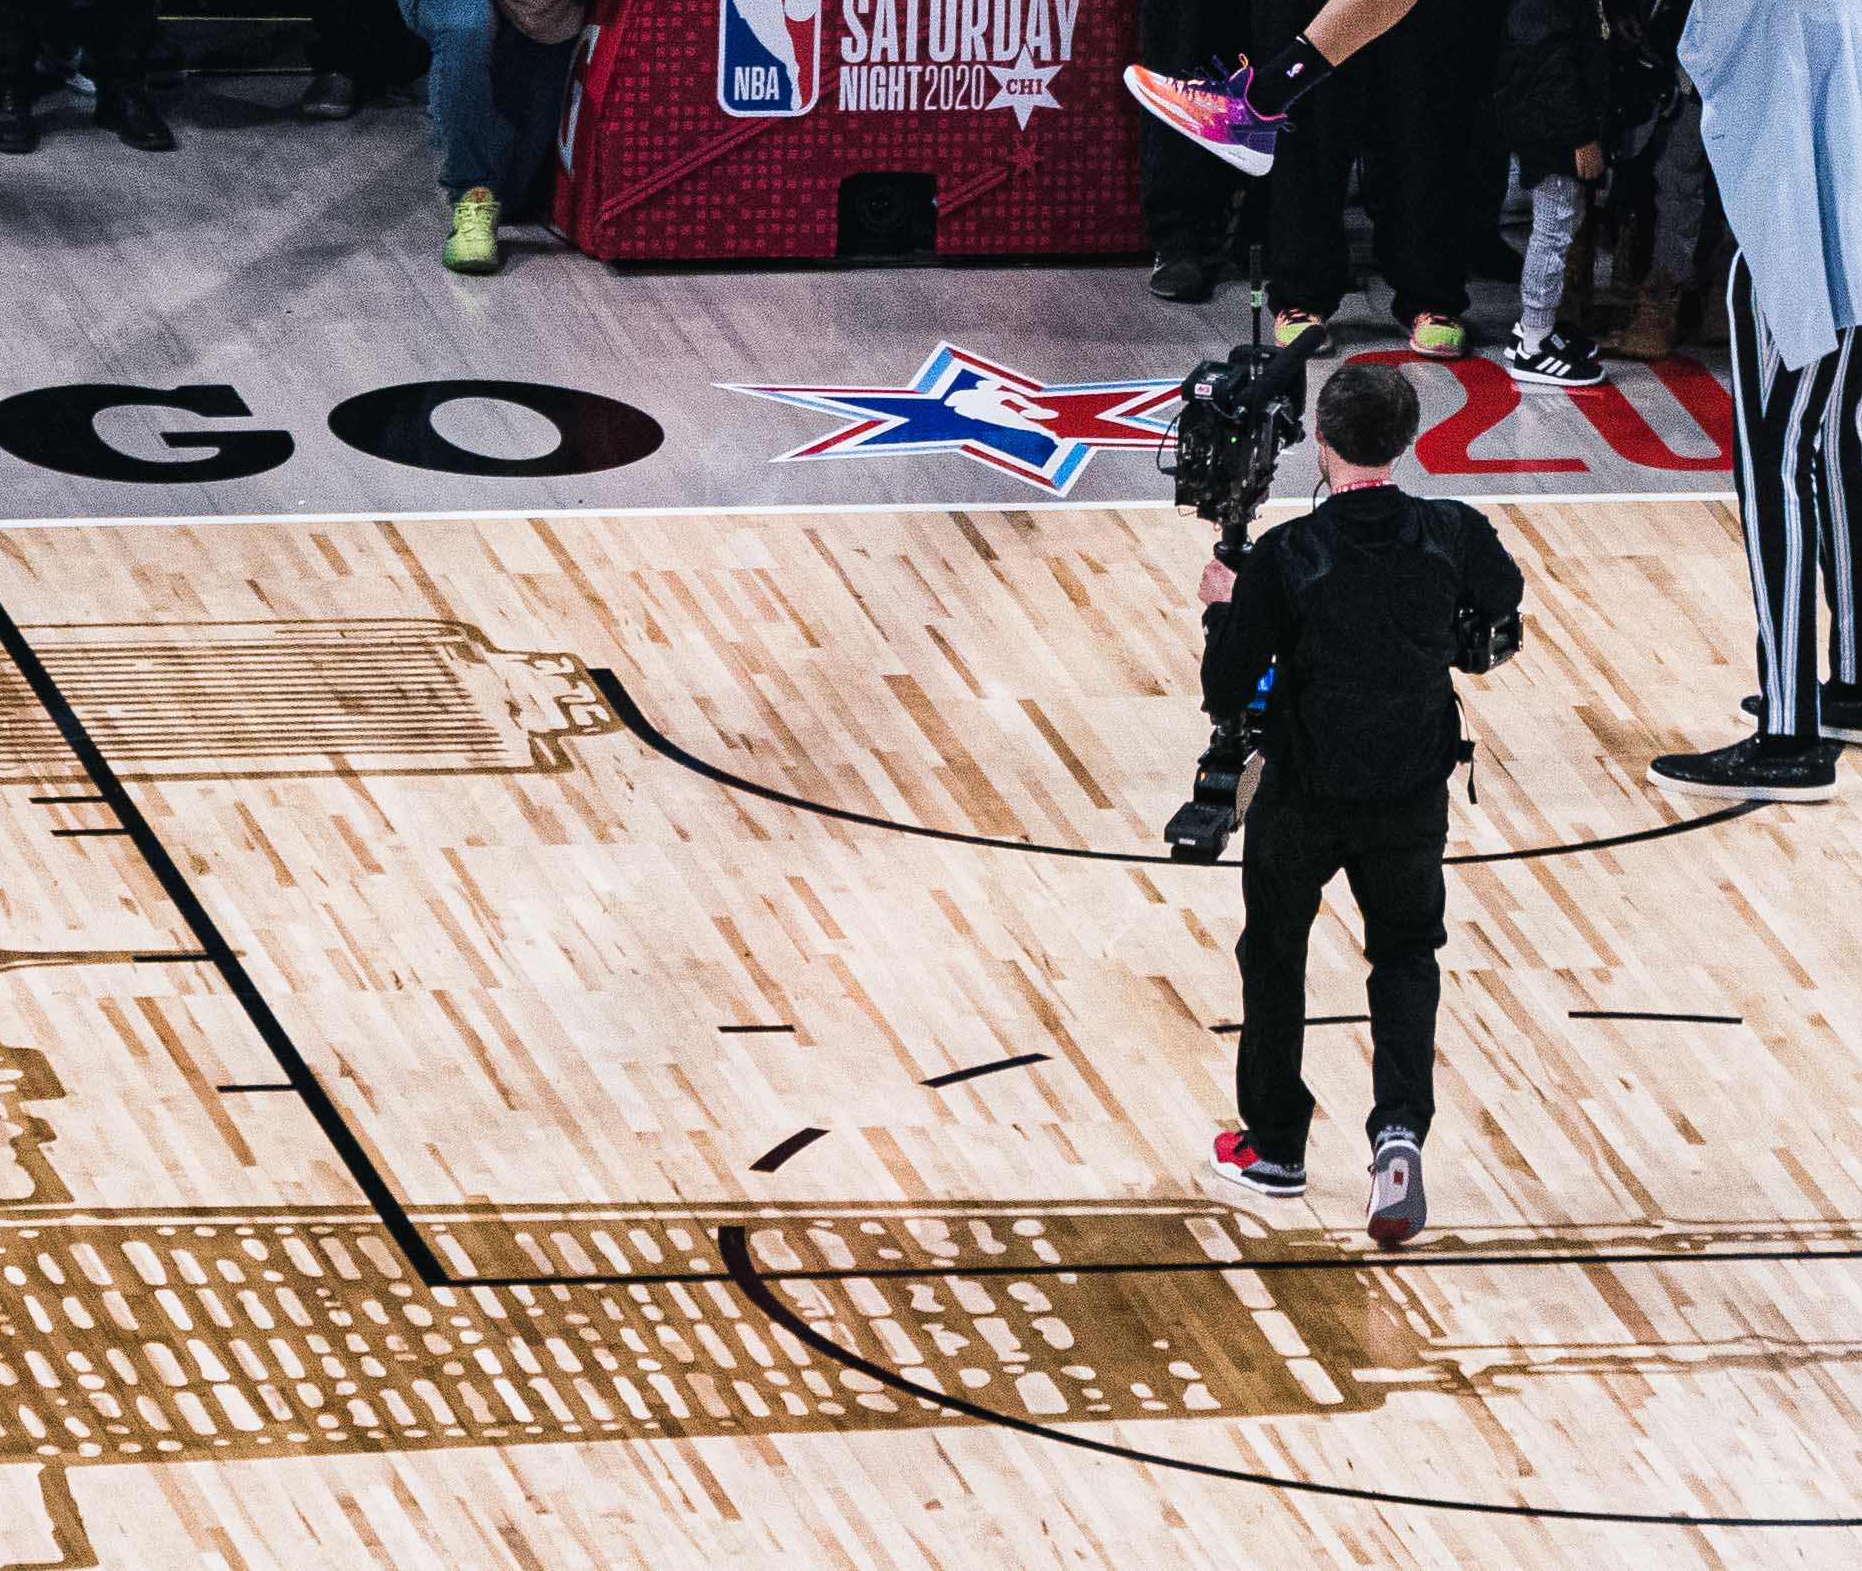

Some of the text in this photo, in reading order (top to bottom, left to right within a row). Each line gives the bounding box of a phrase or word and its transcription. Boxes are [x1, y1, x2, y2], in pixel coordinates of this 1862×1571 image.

[733, 66, 781, 102] NBA
[838, 64, 986, 112] NIGHT 2020
[1005, 77, 1045, 96] CHI
